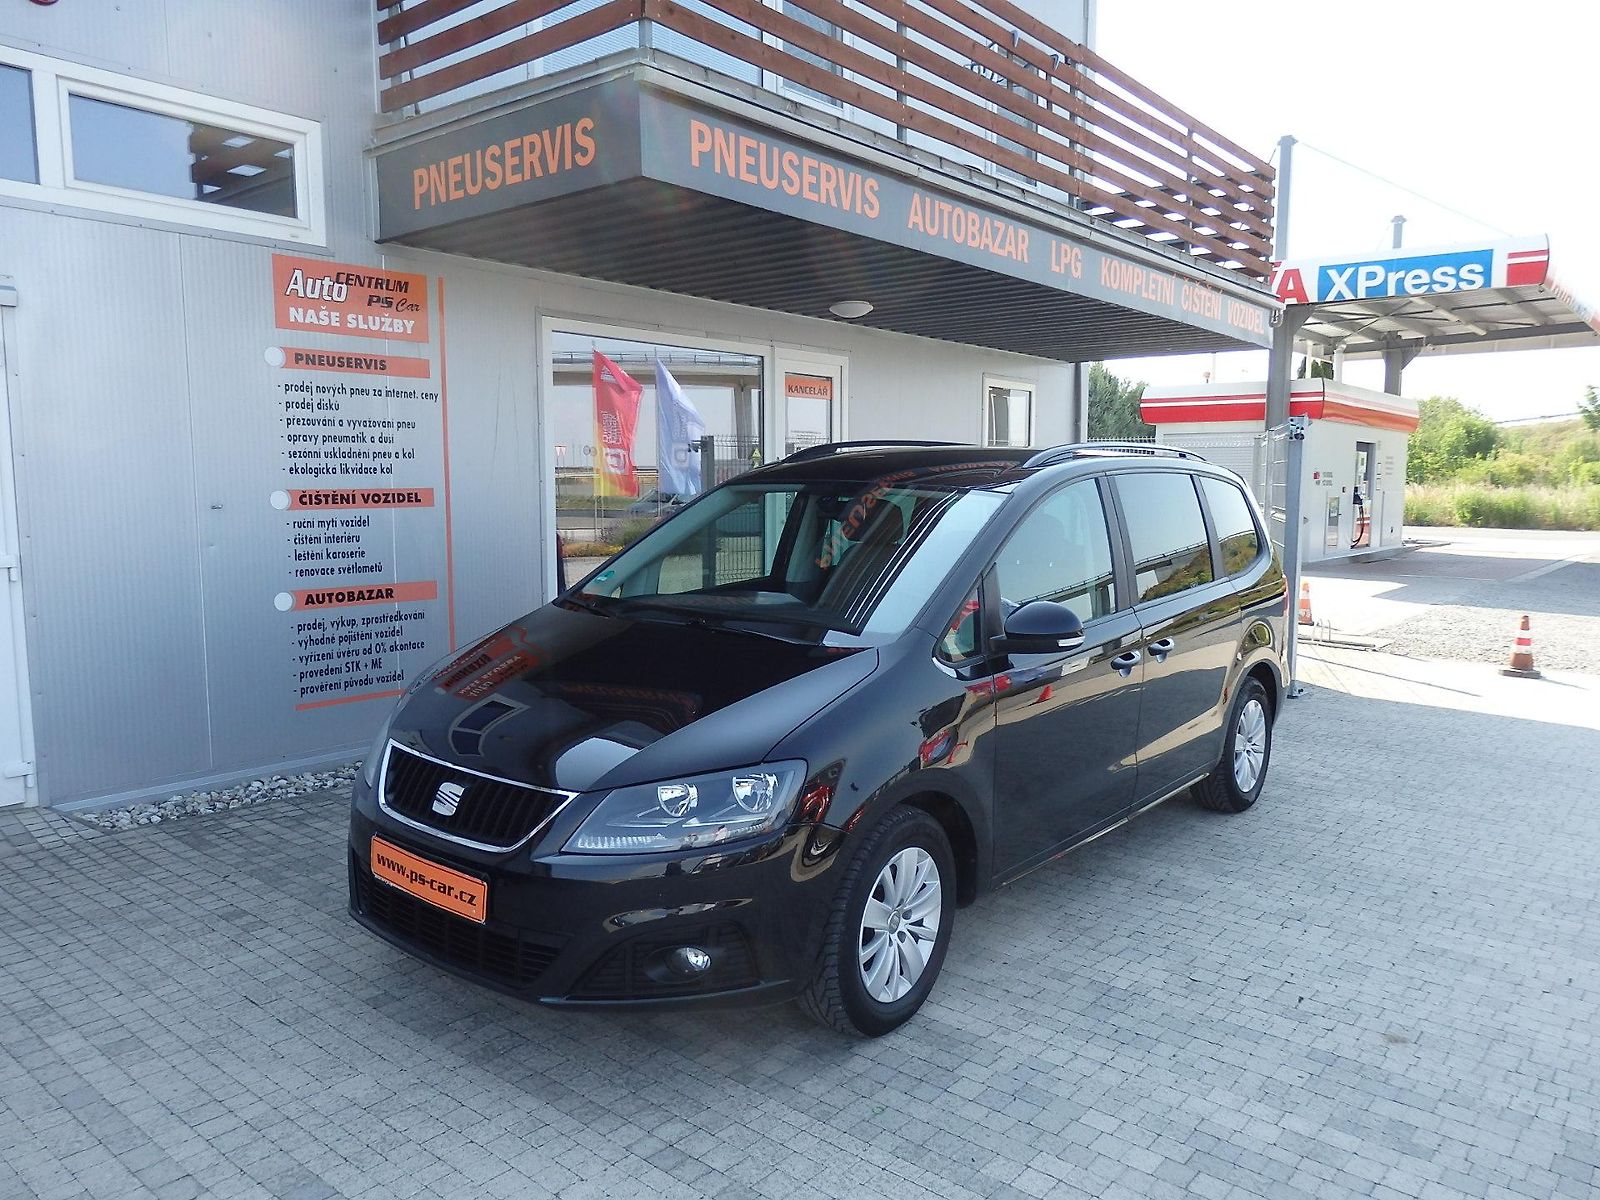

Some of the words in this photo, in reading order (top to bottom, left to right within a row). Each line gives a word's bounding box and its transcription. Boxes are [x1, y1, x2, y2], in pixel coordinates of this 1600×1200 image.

[413, 117, 596, 210] PNEUSERVIS
[690, 119, 880, 219] PNEUSERVIS
[906, 192, 1029, 263] AUTOBAZAR
[1050, 240, 1083, 279] LPG
[1100, 256, 1176, 306] KOMPLETNÍ
[1227, 301, 1265, 335] VOZIDEL
[285, 268, 348, 302] Auto
[336, 272, 409, 293] CENTRUM
[1325, 263, 1485, 301] XPress
[367, 294, 393, 308] PS
[395, 299, 420, 313] Car
[289, 306, 340, 327] NAŠE
[347, 313, 415, 334] SLUŽBY
[294, 353, 387, 371] PNEUSERVIS
[285, 381, 313, 396] prodej
[316, 383, 346, 397] nových
[350, 387, 369, 398] pneu
[373, 389, 382, 397] za
[385, 387, 418, 399] internet.
[421, 391, 439, 403] ceny
[787, 384, 828, 396] KANCELÁŘ
[286, 398, 314, 413] prodej
[397, 420, 416, 431] pneu
[287, 434, 318, 445] opravy
[323, 433, 367, 445] pneumatik
[371, 435, 376, 444] a
[372, 450, 392, 461] pneu
[395, 451, 400, 459] a
[403, 448, 415, 459] kol
[289, 463, 337, 477] ekologická
[340, 463, 378, 475] likvidace
[380, 463, 393, 475] kol
[299, 490, 356, 506] ČIŠTĚNÍ
[361, 492, 421, 505] VOZIDEL
[340, 515, 370, 528] vozidel
[326, 547, 366, 560] karoserie
[295, 565, 335, 578] renovace
[305, 588, 394, 605] AUTOBAZAR
[297, 618, 327, 634] prodej,
[375, 626, 403, 639] vozidel
[362, 643, 373, 655] od
[389, 640, 425, 653] akontace
[300, 666, 343, 682] provedení
[345, 661, 361, 673] STK
[371, 657, 383, 669] ME
[376, 670, 404, 683] vozidel
[376, 853, 477, 907] www.ps-car.cz
